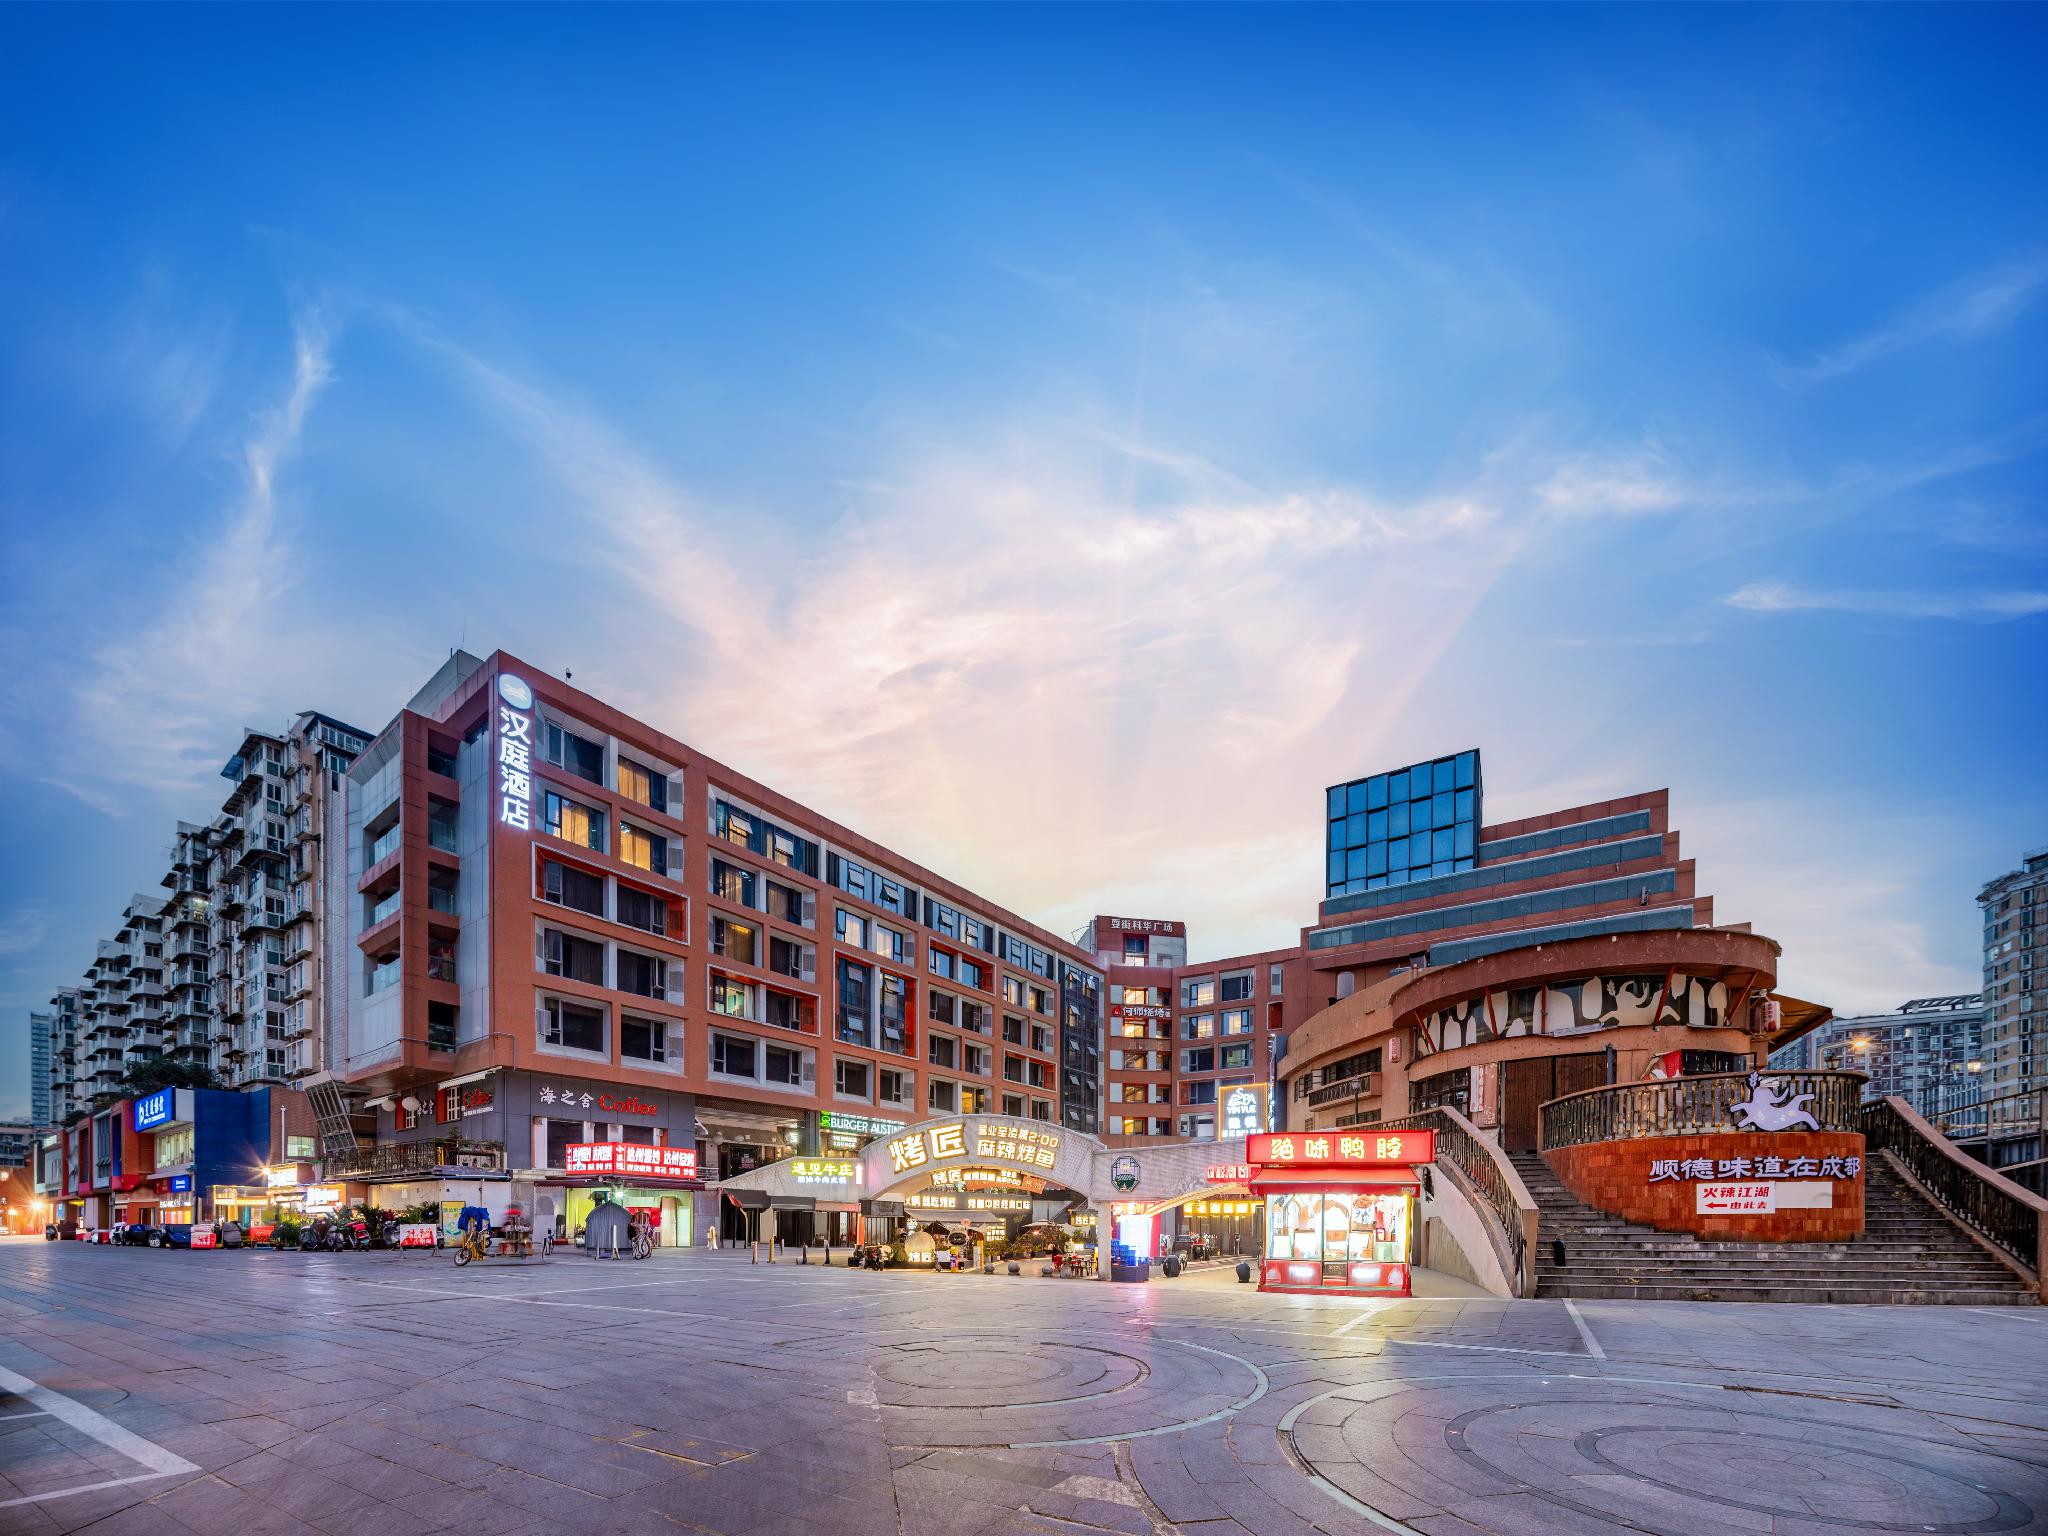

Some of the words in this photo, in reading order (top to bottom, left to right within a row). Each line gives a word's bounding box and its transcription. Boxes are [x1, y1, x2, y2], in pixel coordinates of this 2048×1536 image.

[500, 706, 531, 831] 汉庭酒店
[539, 1086, 595, 1109] 海之舍
[599, 1093, 658, 1116] Coffee
[830, 1117, 868, 1132] BURGER
[978, 1124, 1059, 1148] 营业至凌晨2:00
[888, 1123, 968, 1172] 烤匠
[977, 1139, 1056, 1168] 麻辣烤鱼
[1270, 1137, 1403, 1160] 绝味鸭脖
[792, 1161, 853, 1177] 遇见牛庄
[932, 1170, 961, 1186] 烤匠
[1649, 1156, 1861, 1182] 顺德味道在成都
[1703, 1187, 1769, 1198] 火辣江湖
